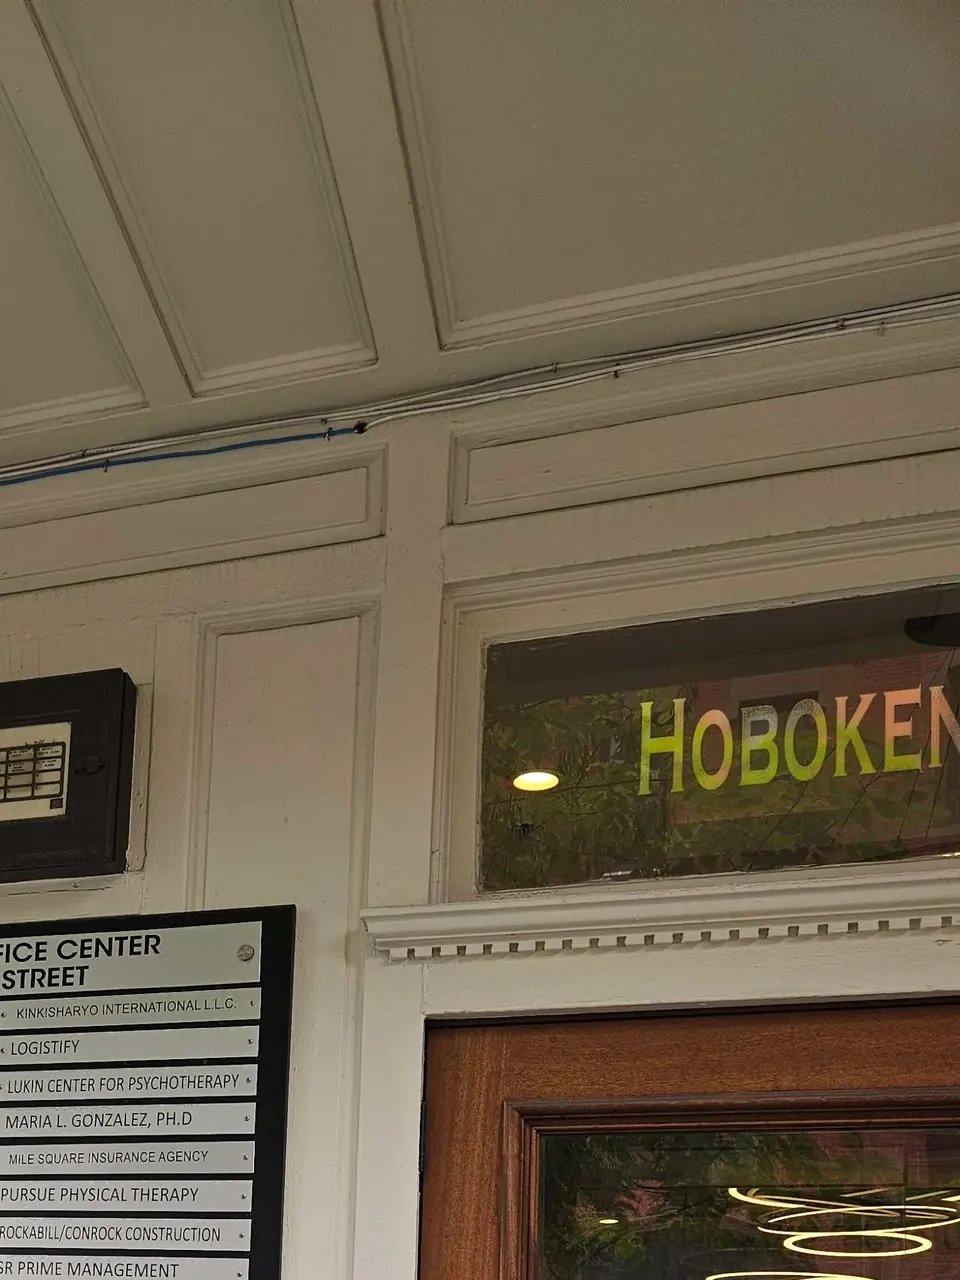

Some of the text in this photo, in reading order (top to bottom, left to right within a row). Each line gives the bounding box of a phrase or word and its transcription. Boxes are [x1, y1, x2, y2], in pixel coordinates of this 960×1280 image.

[638, 683, 960, 796] HOBOKEN
[57, 934, 160, 961] CENTER
[2, 966, 91, 992] STREET
[17, 998, 236, 1019] KINKISHARYO INTERNATIONAL L.L.C.
[11, 1040, 79, 1055] LOGISTIFY
[8, 1074, 239, 1093] LUKIN CENTER FOR PSYCHOTHERAPY
[6, 1112, 191, 1128] MARIA L. GONZALEZ, PH.D
[9, 1151, 208, 1164] MILE SQUARE INSURANCE AGENCY
[1, 1188, 198, 1201] PURSUE PHYSICAL THERAPY
[0, 1225, 220, 1242] ROCKABILL/CONROCK CONSTRUCTION
[18, 1262, 62, 1275] PRIME
[68, 1262, 179, 1277] MANAGEMENT
